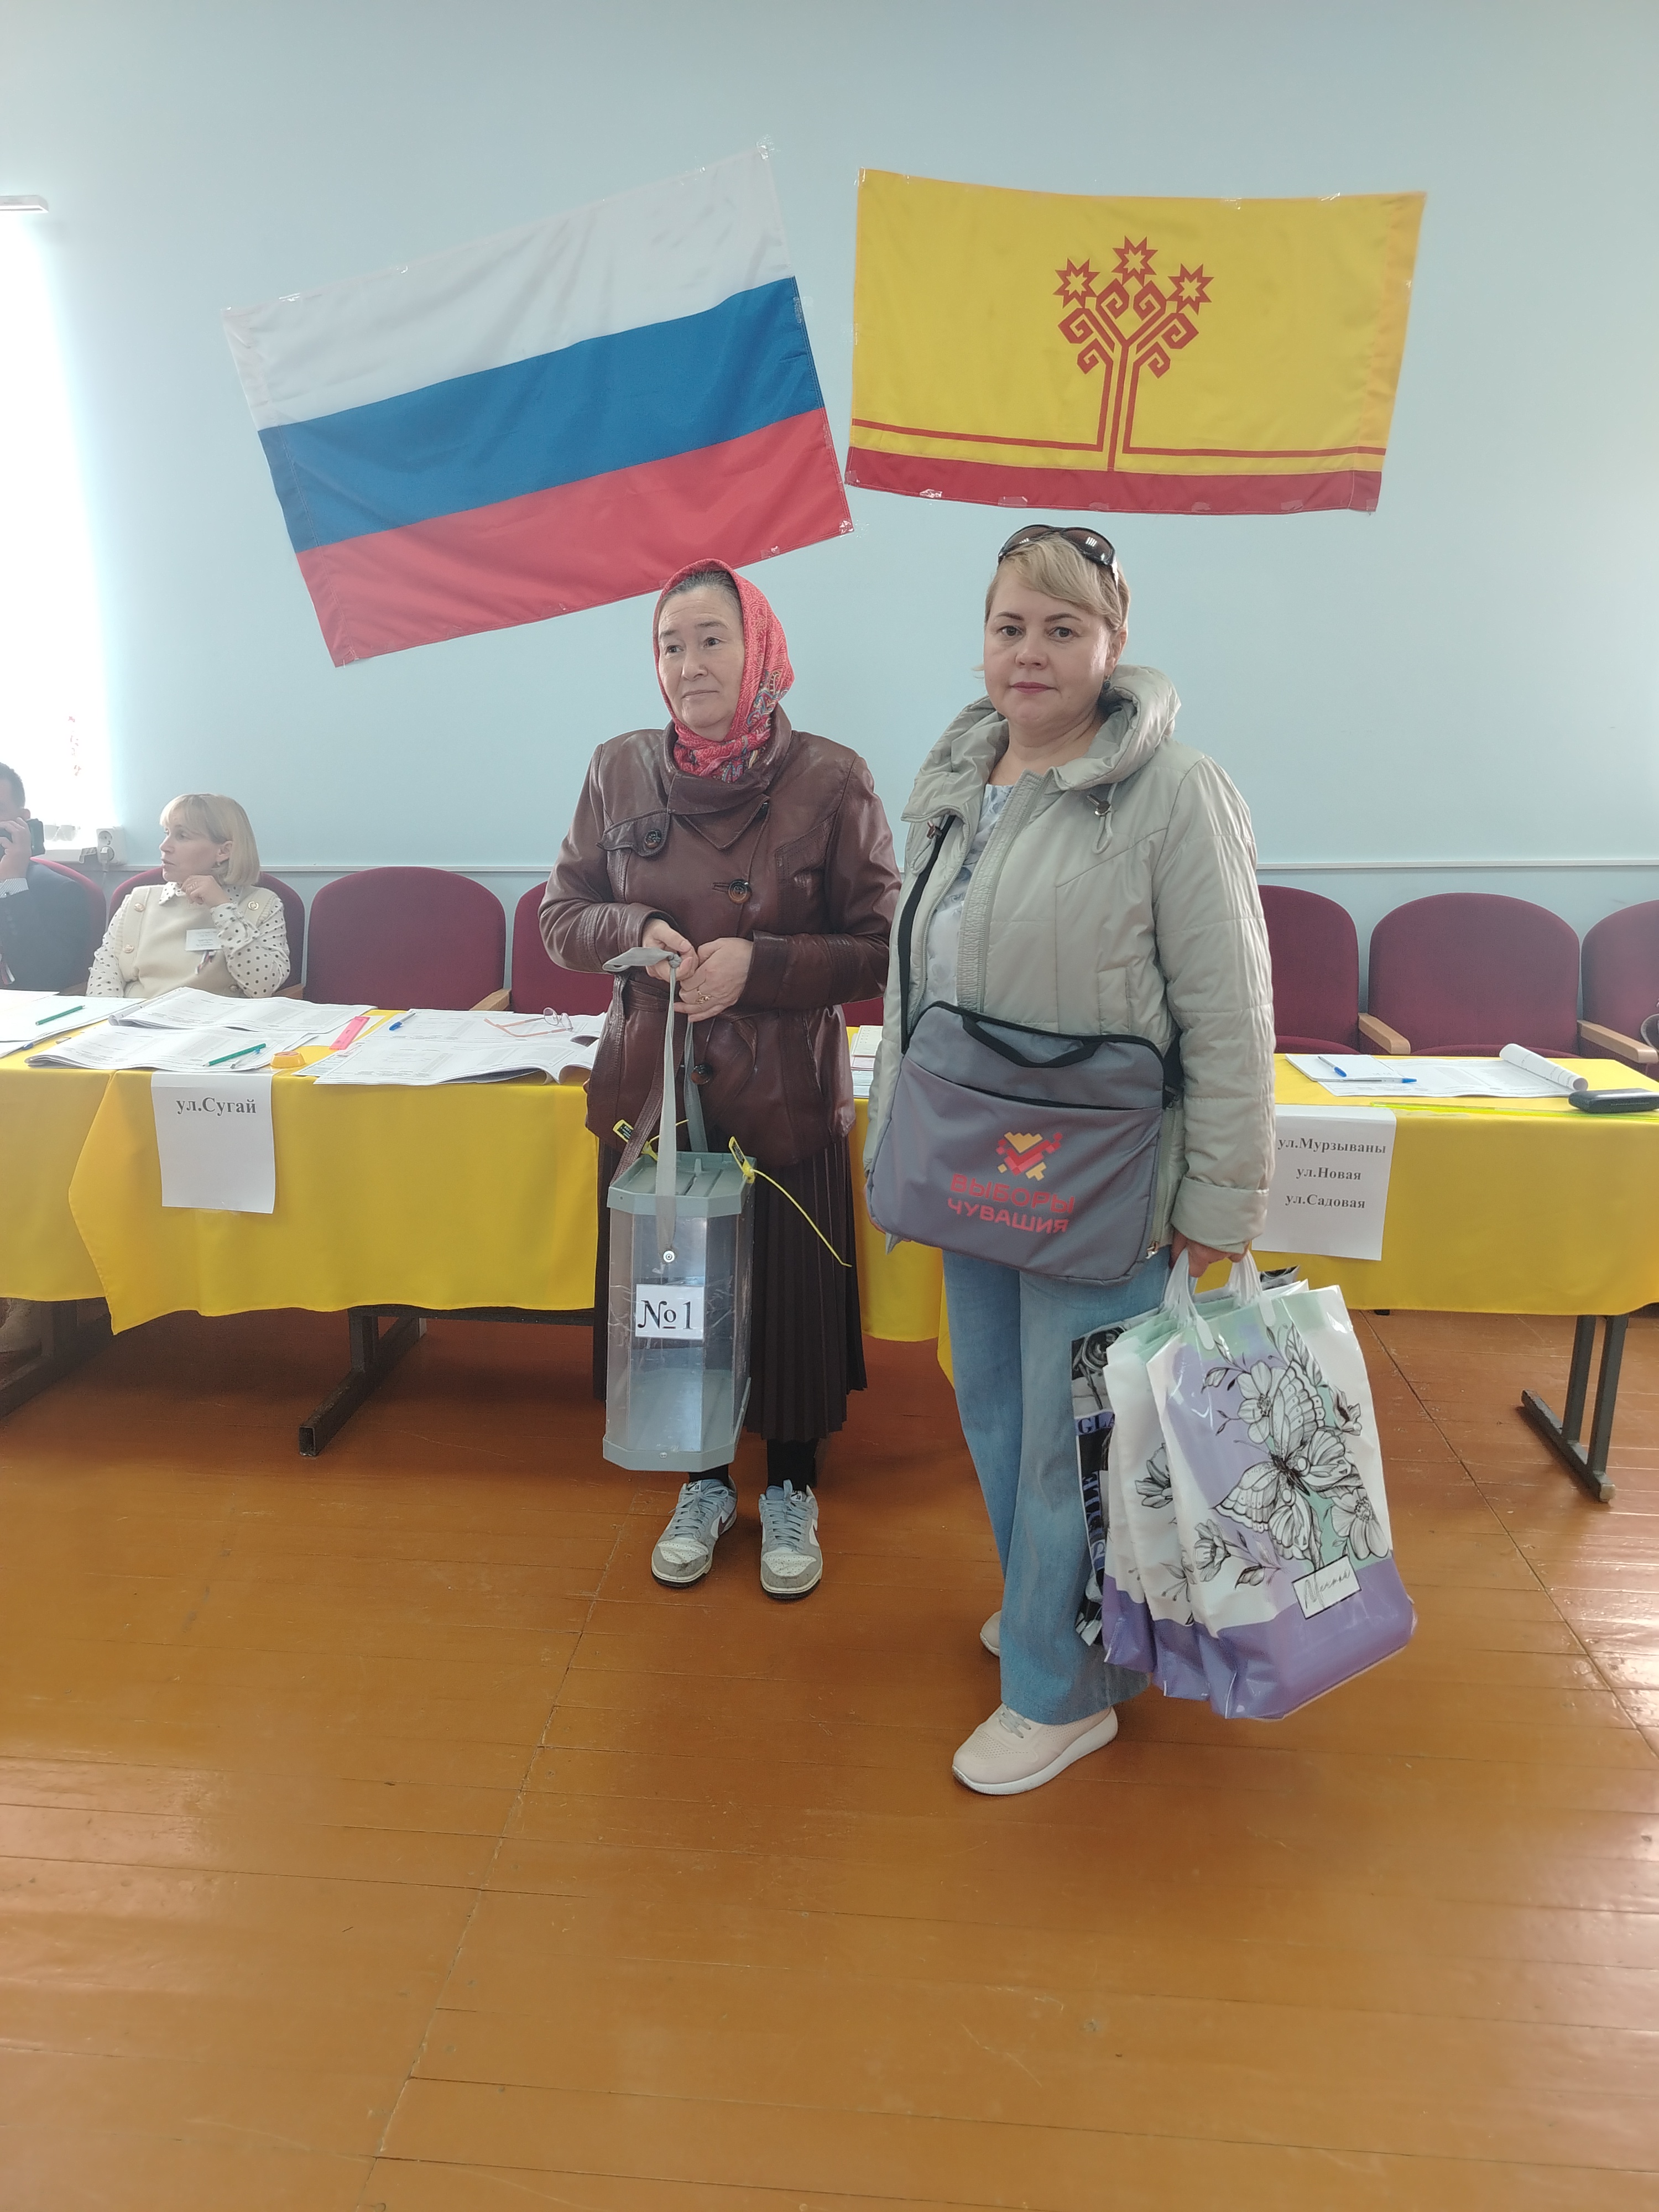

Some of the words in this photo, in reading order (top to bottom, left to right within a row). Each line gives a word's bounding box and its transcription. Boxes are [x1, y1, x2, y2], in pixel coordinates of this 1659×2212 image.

[176, 1097, 257, 1117] ул.Сугай
[1277, 1138, 1386, 1154] ул.Мурзываны
[1296, 1167, 1361, 1180] ул.Новая
[951, 1173, 1075, 1213] ВЫБОРЫ
[1285, 1194, 1365, 1208] ул.Садовая
[947, 1197, 1070, 1234] ЧУВАШИЯ
